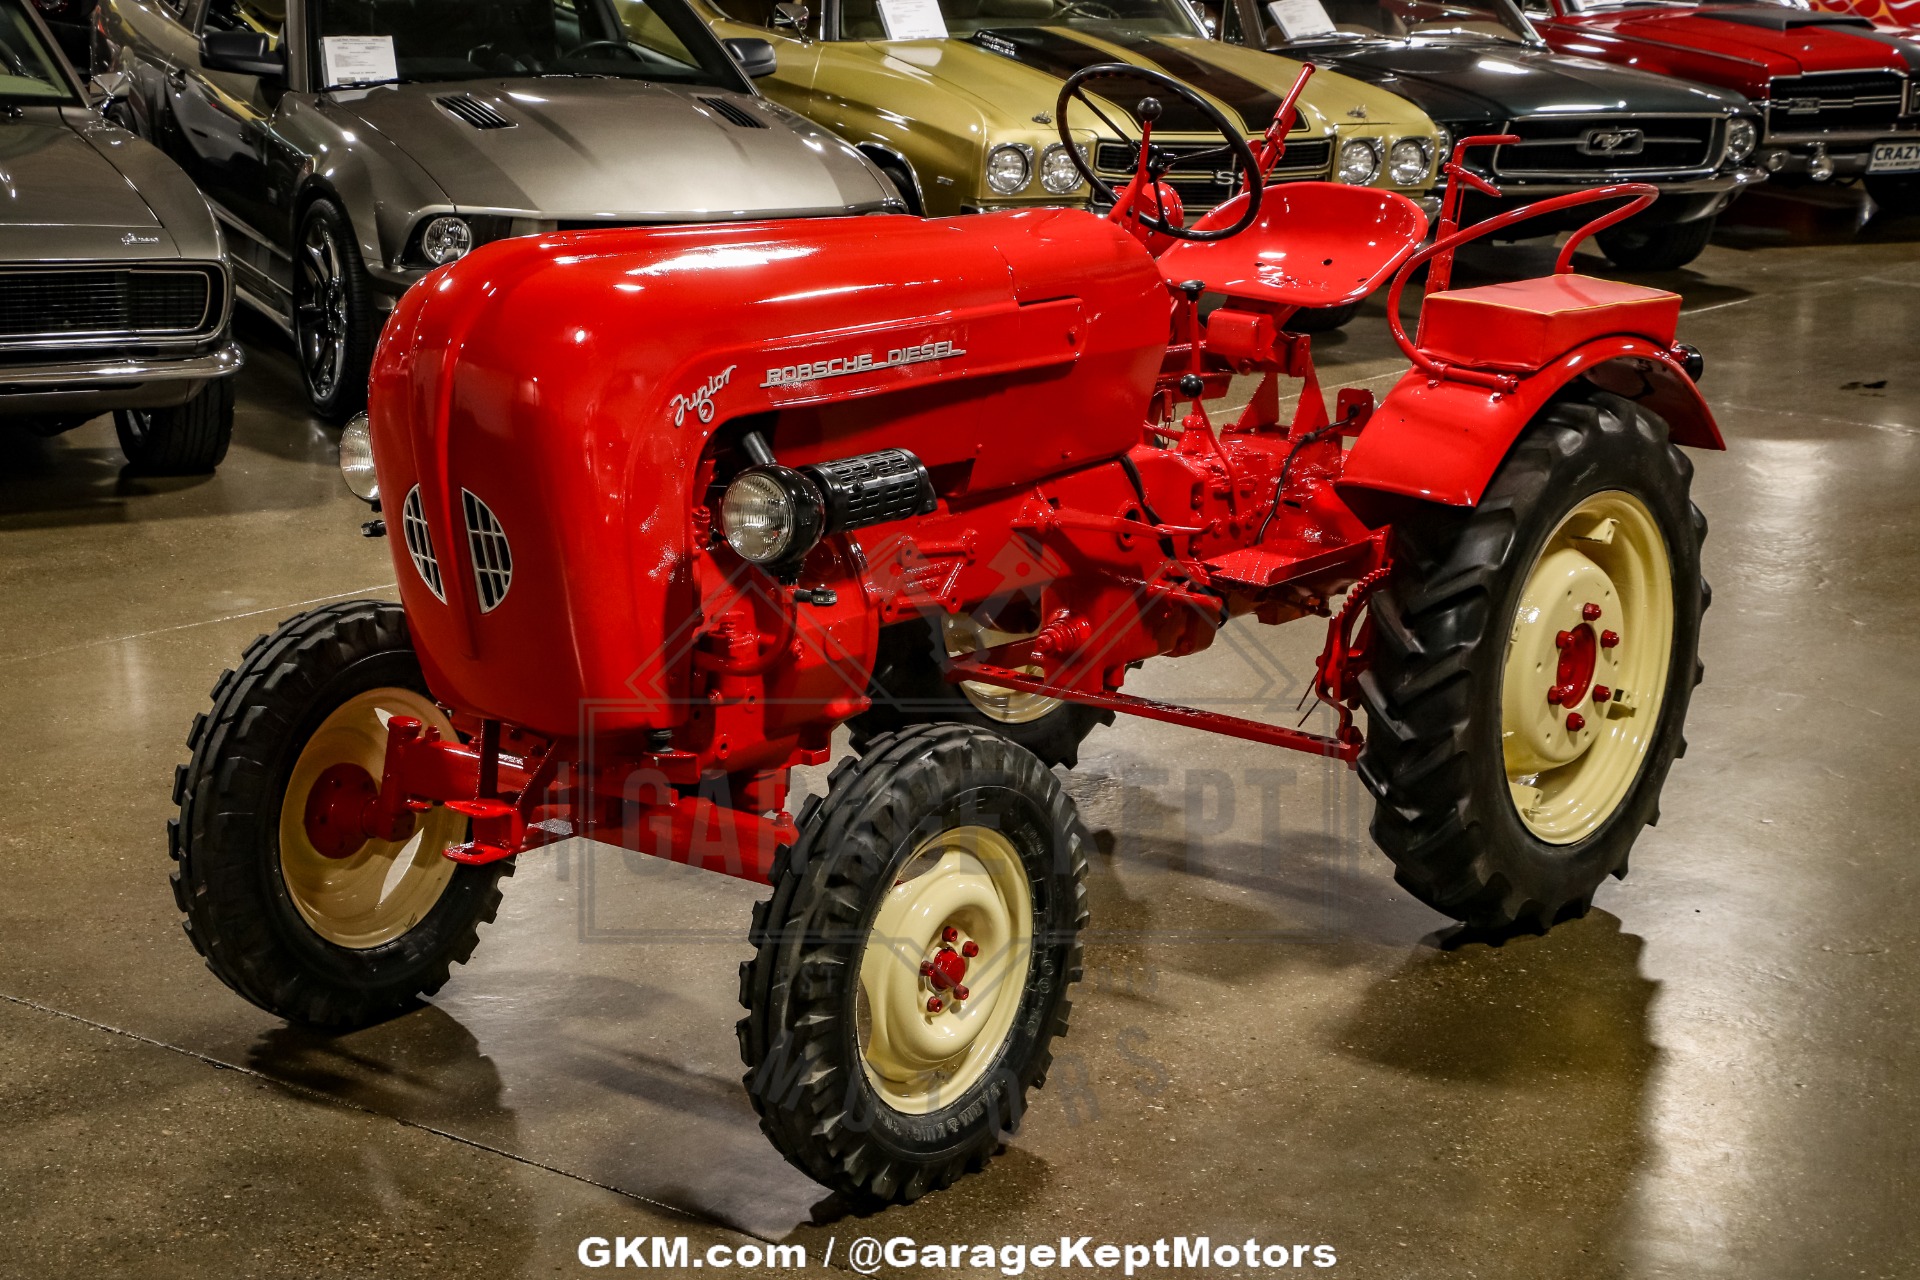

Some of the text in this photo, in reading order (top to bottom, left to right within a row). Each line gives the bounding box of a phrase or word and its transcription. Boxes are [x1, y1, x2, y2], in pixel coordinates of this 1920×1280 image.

[1874, 145, 1920, 161] CRAZY
[762, 340, 966, 387] PORSCHE DIESEL
[670, 365, 737, 427] Junior
